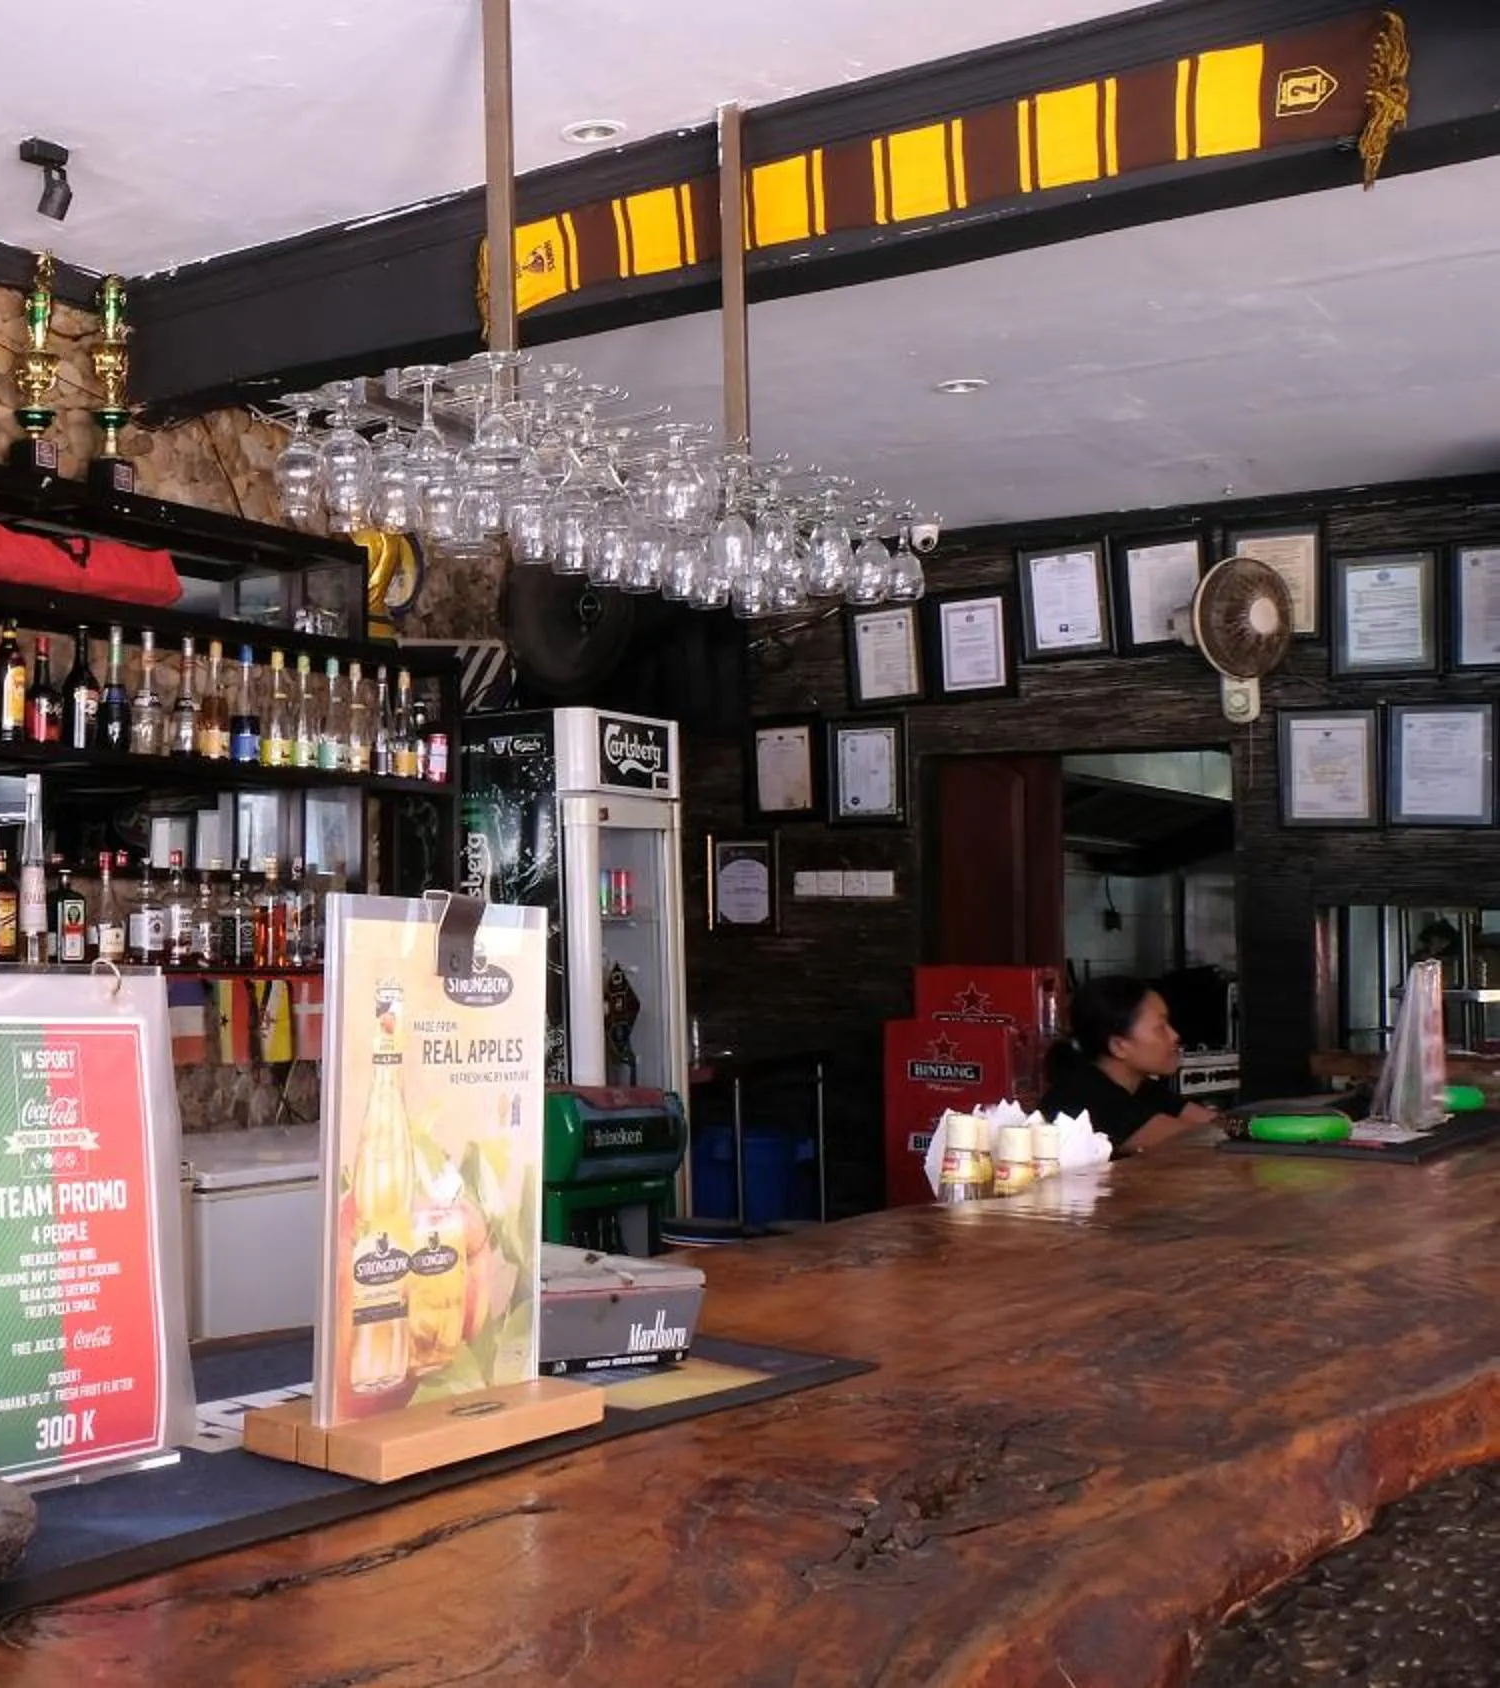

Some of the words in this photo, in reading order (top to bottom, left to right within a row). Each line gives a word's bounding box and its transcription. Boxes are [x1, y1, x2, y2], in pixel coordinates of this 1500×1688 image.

[604, 723, 662, 775] Carlsberg
[447, 976, 511, 993] STRONGBOW
[21, 1050, 33, 1070] W
[35, 1050, 77, 1070] SPORT
[422, 1039, 463, 1065] REAL
[467, 1039, 524, 1065] APPLES
[913, 1063, 976, 1080] BINTANG
[593, 1124, 644, 1148] Heineken
[58, 1179, 127, 1215] PROMO
[31, 1225, 41, 1244] 4
[43, 1221, 89, 1244] PEOPLE
[356, 1256, 410, 1277] STRONGBOW
[627, 1309, 690, 1351] Marlboro
[35, 1413, 77, 1451] 300
[81, 1409, 97, 1442] K
